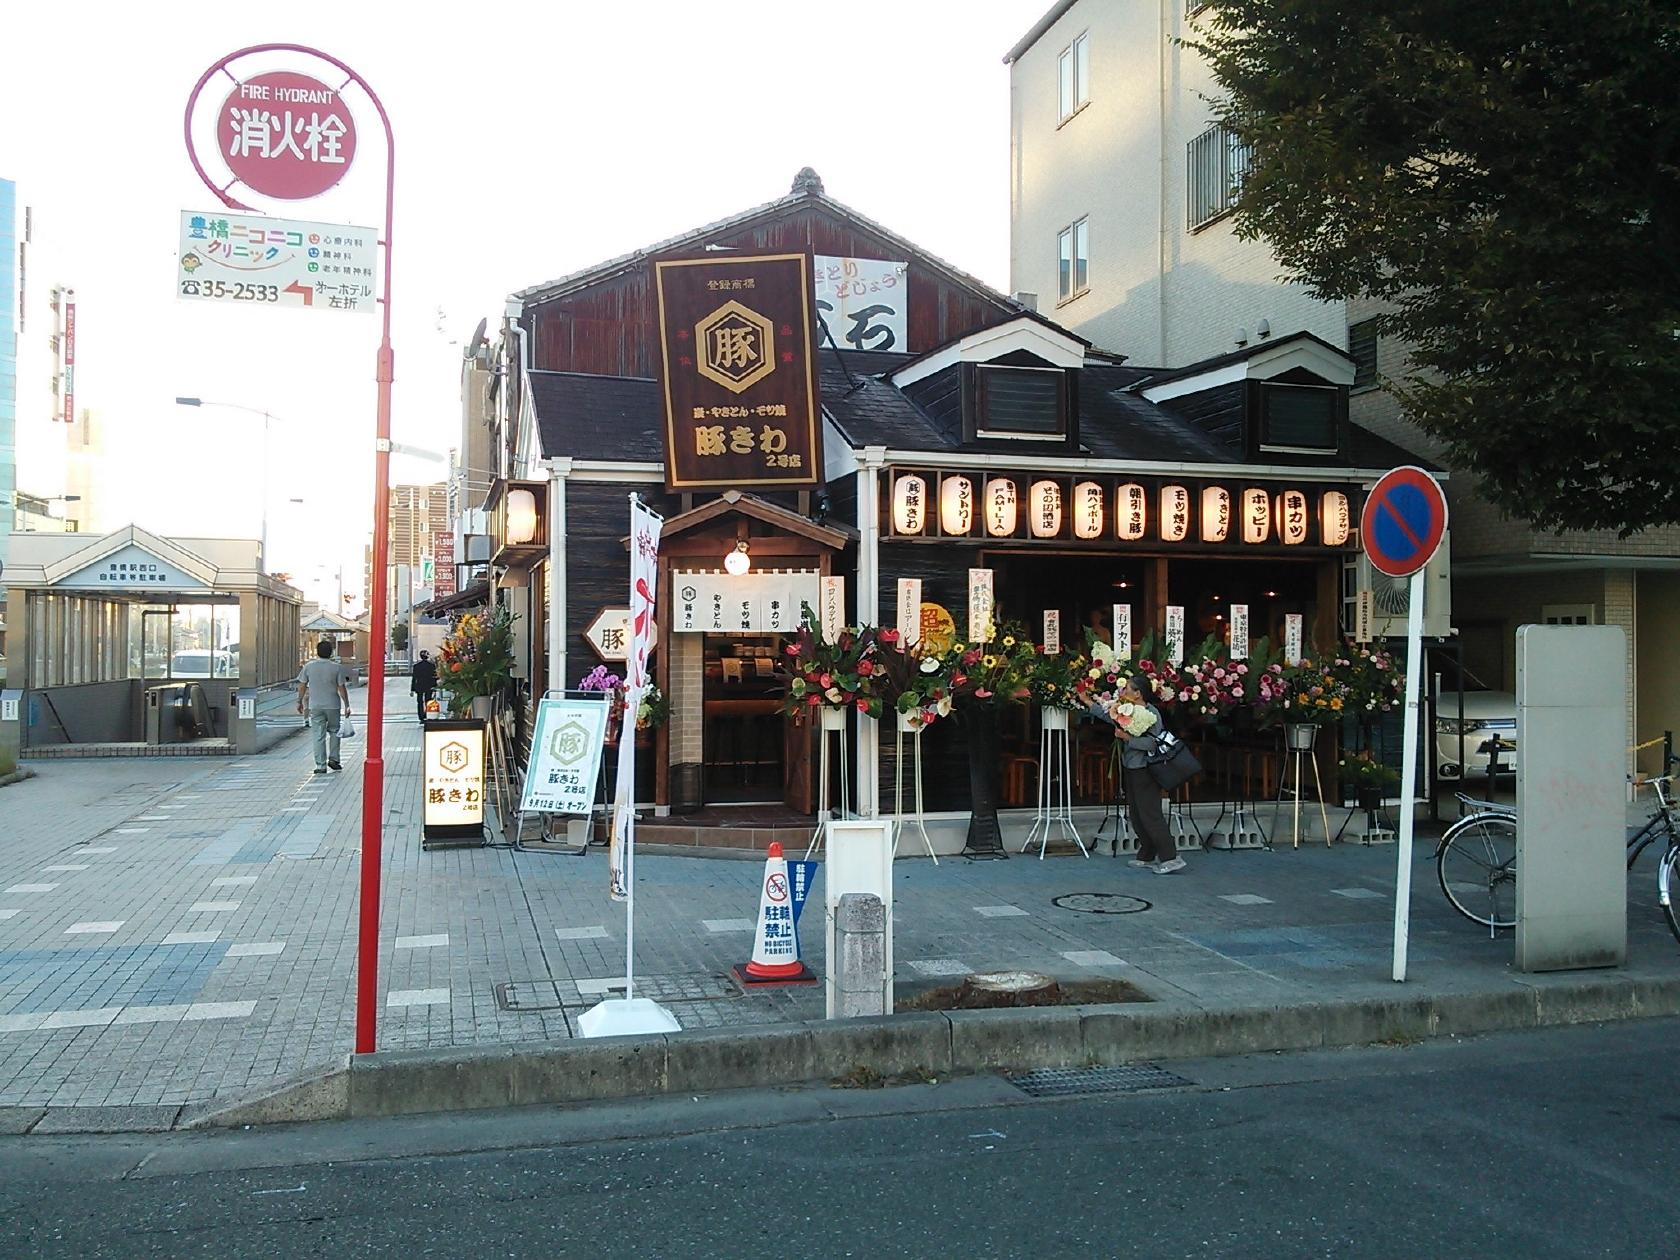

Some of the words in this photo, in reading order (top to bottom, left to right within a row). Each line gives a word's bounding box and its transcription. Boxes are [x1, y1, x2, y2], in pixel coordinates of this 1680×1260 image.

[241, 84, 270, 101] FIRE
[275, 87, 334, 106] HYDRANT
[229, 107, 348, 164] 消火栓
[188, 216, 303, 247] 豊橋ニコニコ
[323, 235, 363, 248] 心療内科
[208, 240, 279, 263] クリニック
[323, 250, 352, 261] 精神科
[323, 265, 372, 277] 老年精神科
[203, 280, 279, 304] 35-2533
[328, 295, 358, 310] 左折
[714, 326, 758, 368] 豚
[695, 425, 787, 456] 豚きわ
[766, 454, 802, 468] 2号店
[906, 495, 919, 529] 豚きわ
[958, 481, 969, 528] サントリー
[1252, 494, 1266, 537] ホッピー
[1287, 495, 1302, 537] 串カツ
[771, 600, 780, 629] 串カツ
[600, 628, 625, 650] 豚
[447, 750, 462, 765] 豚
[547, 772, 580, 785] 豚きわ
[428, 787, 480, 804] 豚きわ
[795, 863, 806, 902] 駐輪禁止
[764, 905, 790, 921] 駐輪
[765, 922, 792, 939] 禁止
[764, 947, 793, 955] PARKING
